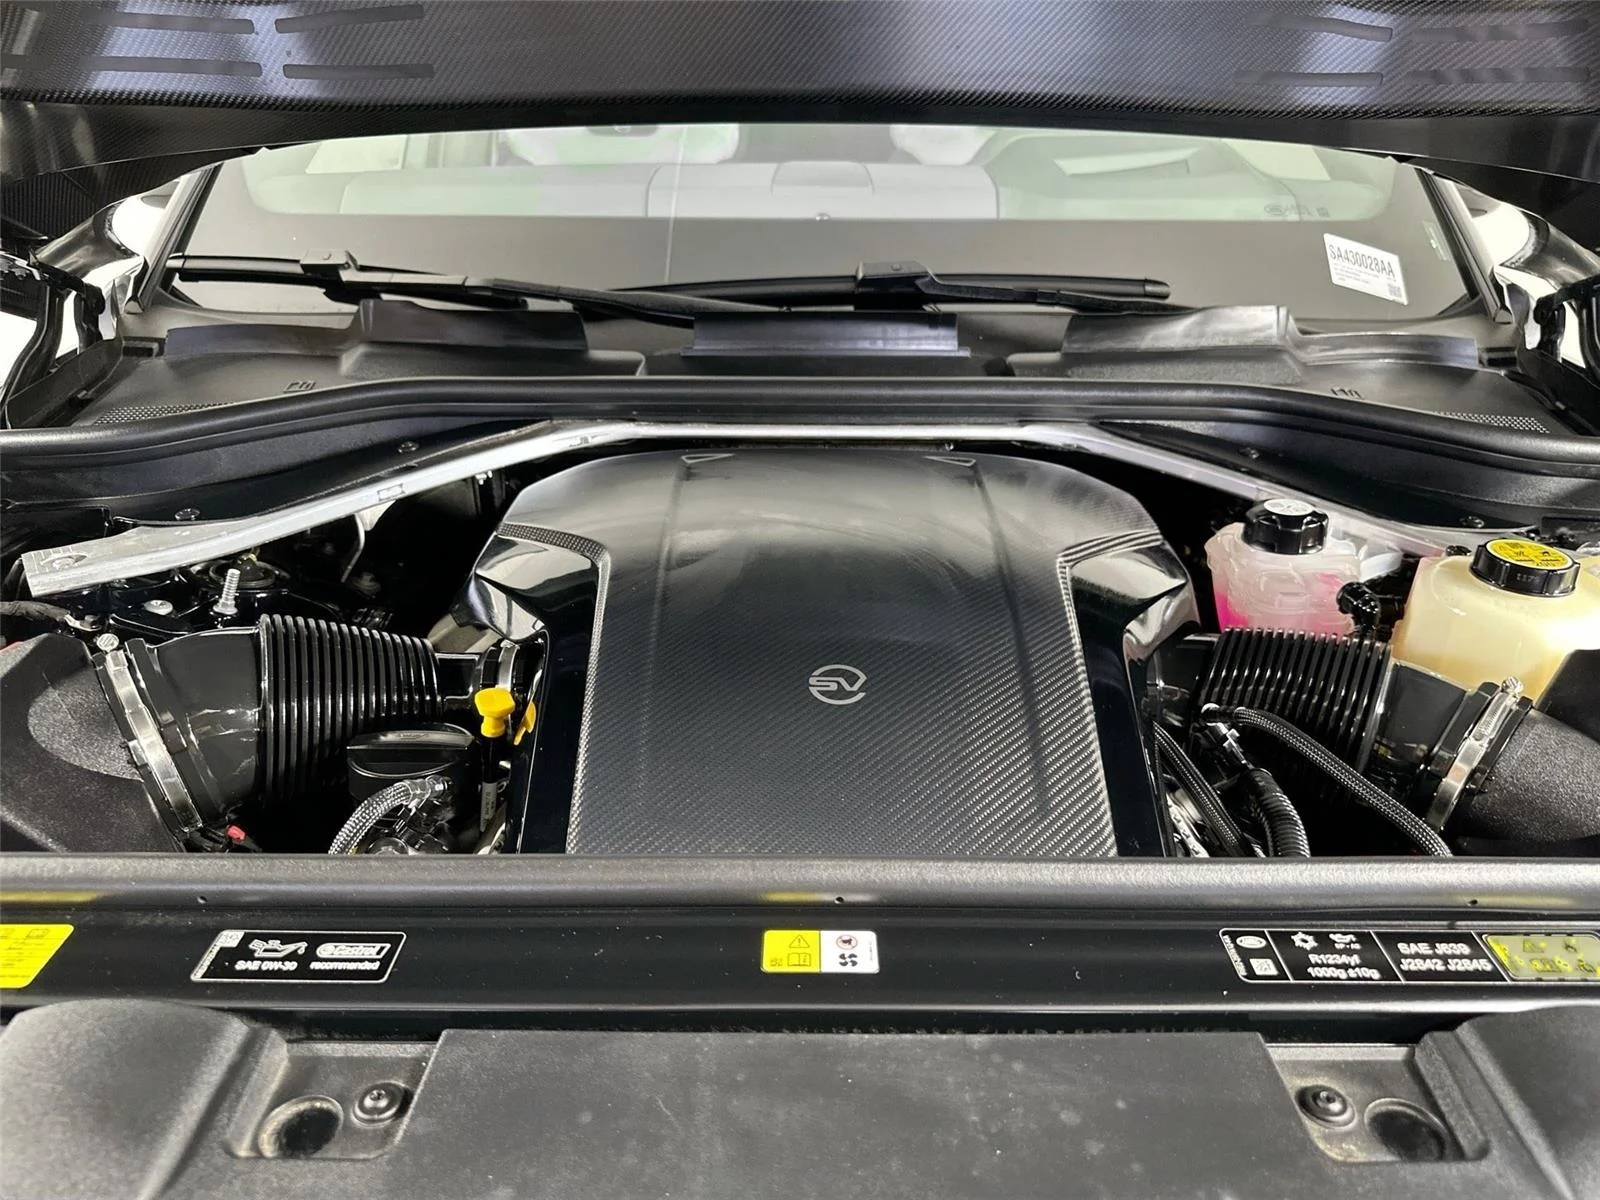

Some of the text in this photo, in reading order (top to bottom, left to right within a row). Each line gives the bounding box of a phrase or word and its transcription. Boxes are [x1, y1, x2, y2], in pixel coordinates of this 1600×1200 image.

[1329, 244, 1395, 278] SA430028AA
[1397, 942, 1433, 955] SAE
[234, 960, 261, 970] SAE
[309, 960, 381, 970] recommended
[1400, 958, 1446, 971] J2842
[1307, 966, 1348, 979] 1000g
